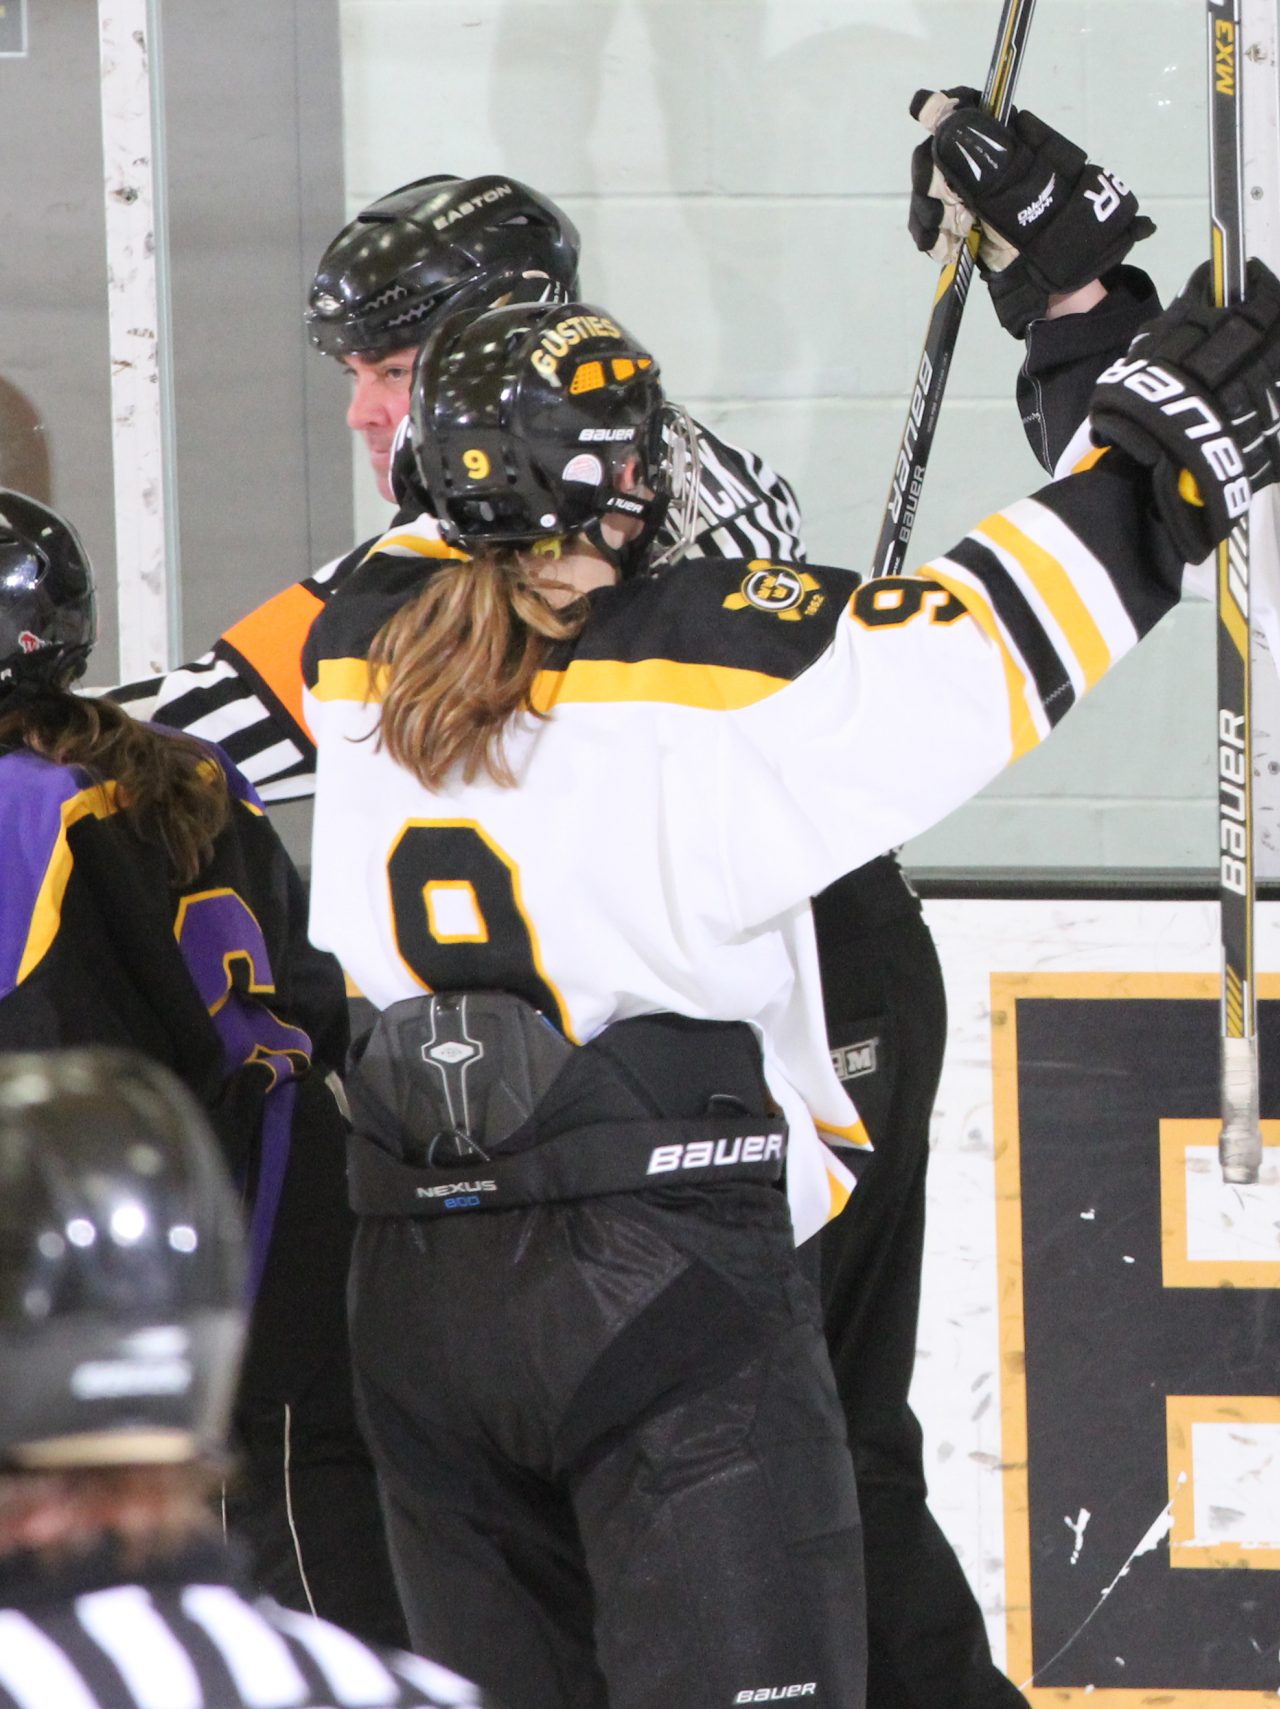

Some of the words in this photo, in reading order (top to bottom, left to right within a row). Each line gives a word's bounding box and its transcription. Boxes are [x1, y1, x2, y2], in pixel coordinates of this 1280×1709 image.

[1214, 18, 1235, 96] MX3
[432, 184, 513, 231] EASTON
[530, 315, 622, 388] GUSTIES
[462, 448, 491, 480] 9
[578, 428, 635, 442] BAUER
[888, 350, 933, 524] BAUER
[1096, 357, 1251, 519] BAUER
[899, 464, 926, 544] BAUER
[1219, 708, 1247, 896] BAUER
[646, 1133, 784, 1176] BAUER
[416, 1180, 498, 1199] NEXUS
[735, 1682, 816, 1704] BAUER
